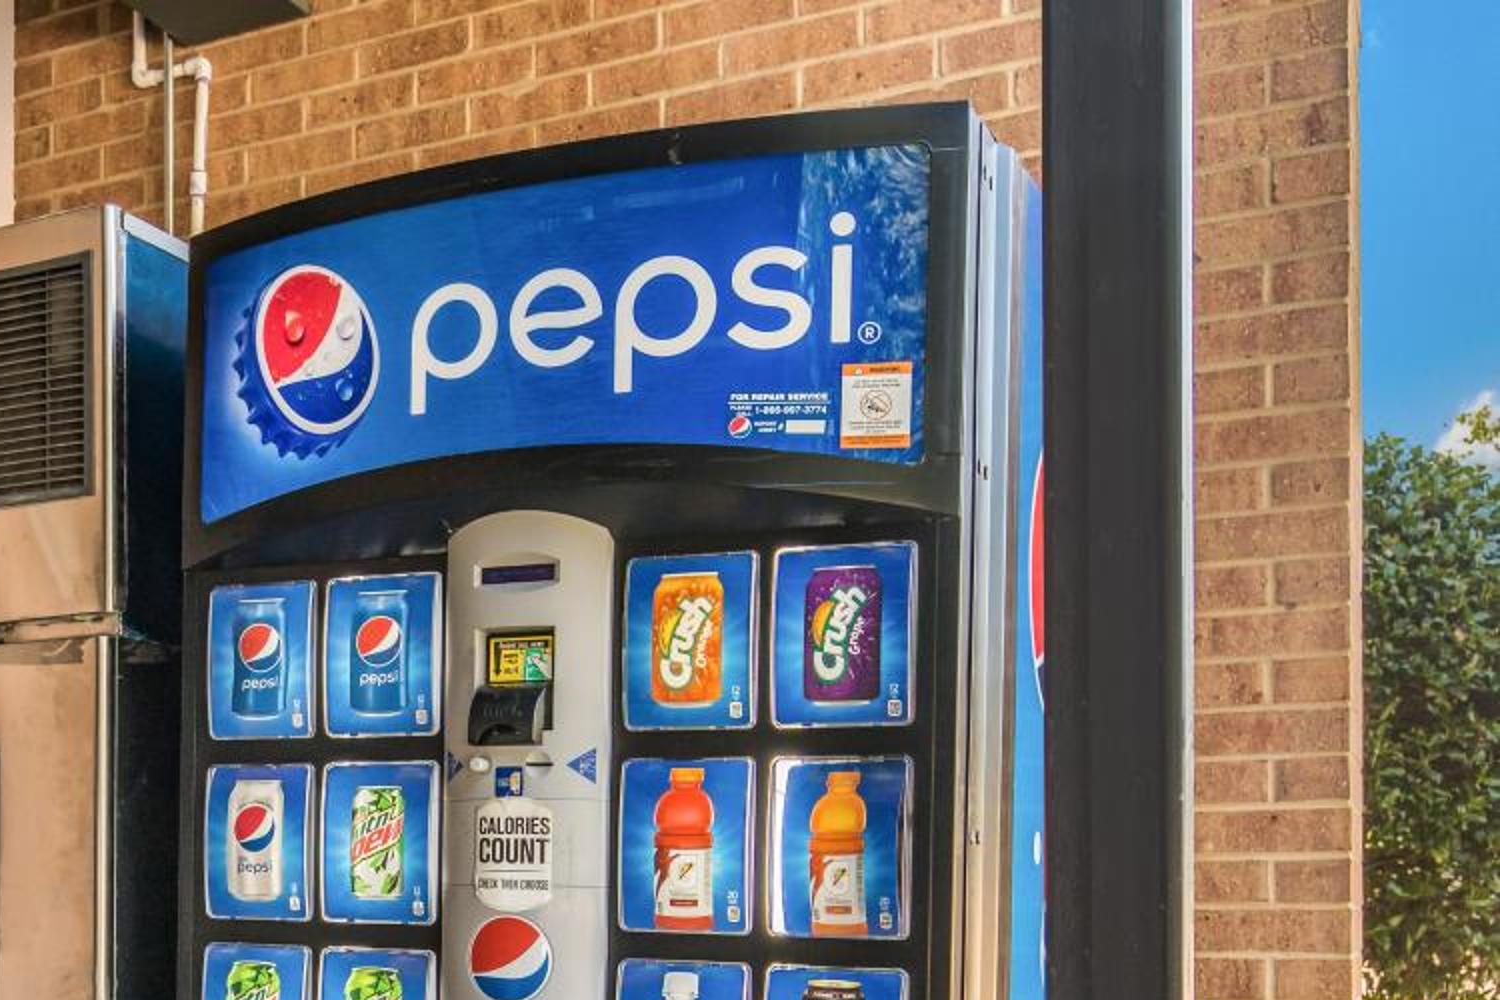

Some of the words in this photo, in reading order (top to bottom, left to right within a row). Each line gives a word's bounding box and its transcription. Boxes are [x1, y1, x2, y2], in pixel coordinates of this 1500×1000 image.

[409, 211, 857, 416] pepsi
[751, 393, 786, 401] REPAIR
[787, 392, 829, 401] SERVICE
[660, 597, 714, 690] Crush
[812, 586, 868, 682] Crush
[241, 675, 279, 692] pepsi
[359, 669, 399, 687] pepsi
[479, 815, 551, 835] CALORIES
[479, 837, 550, 864] COUNT
